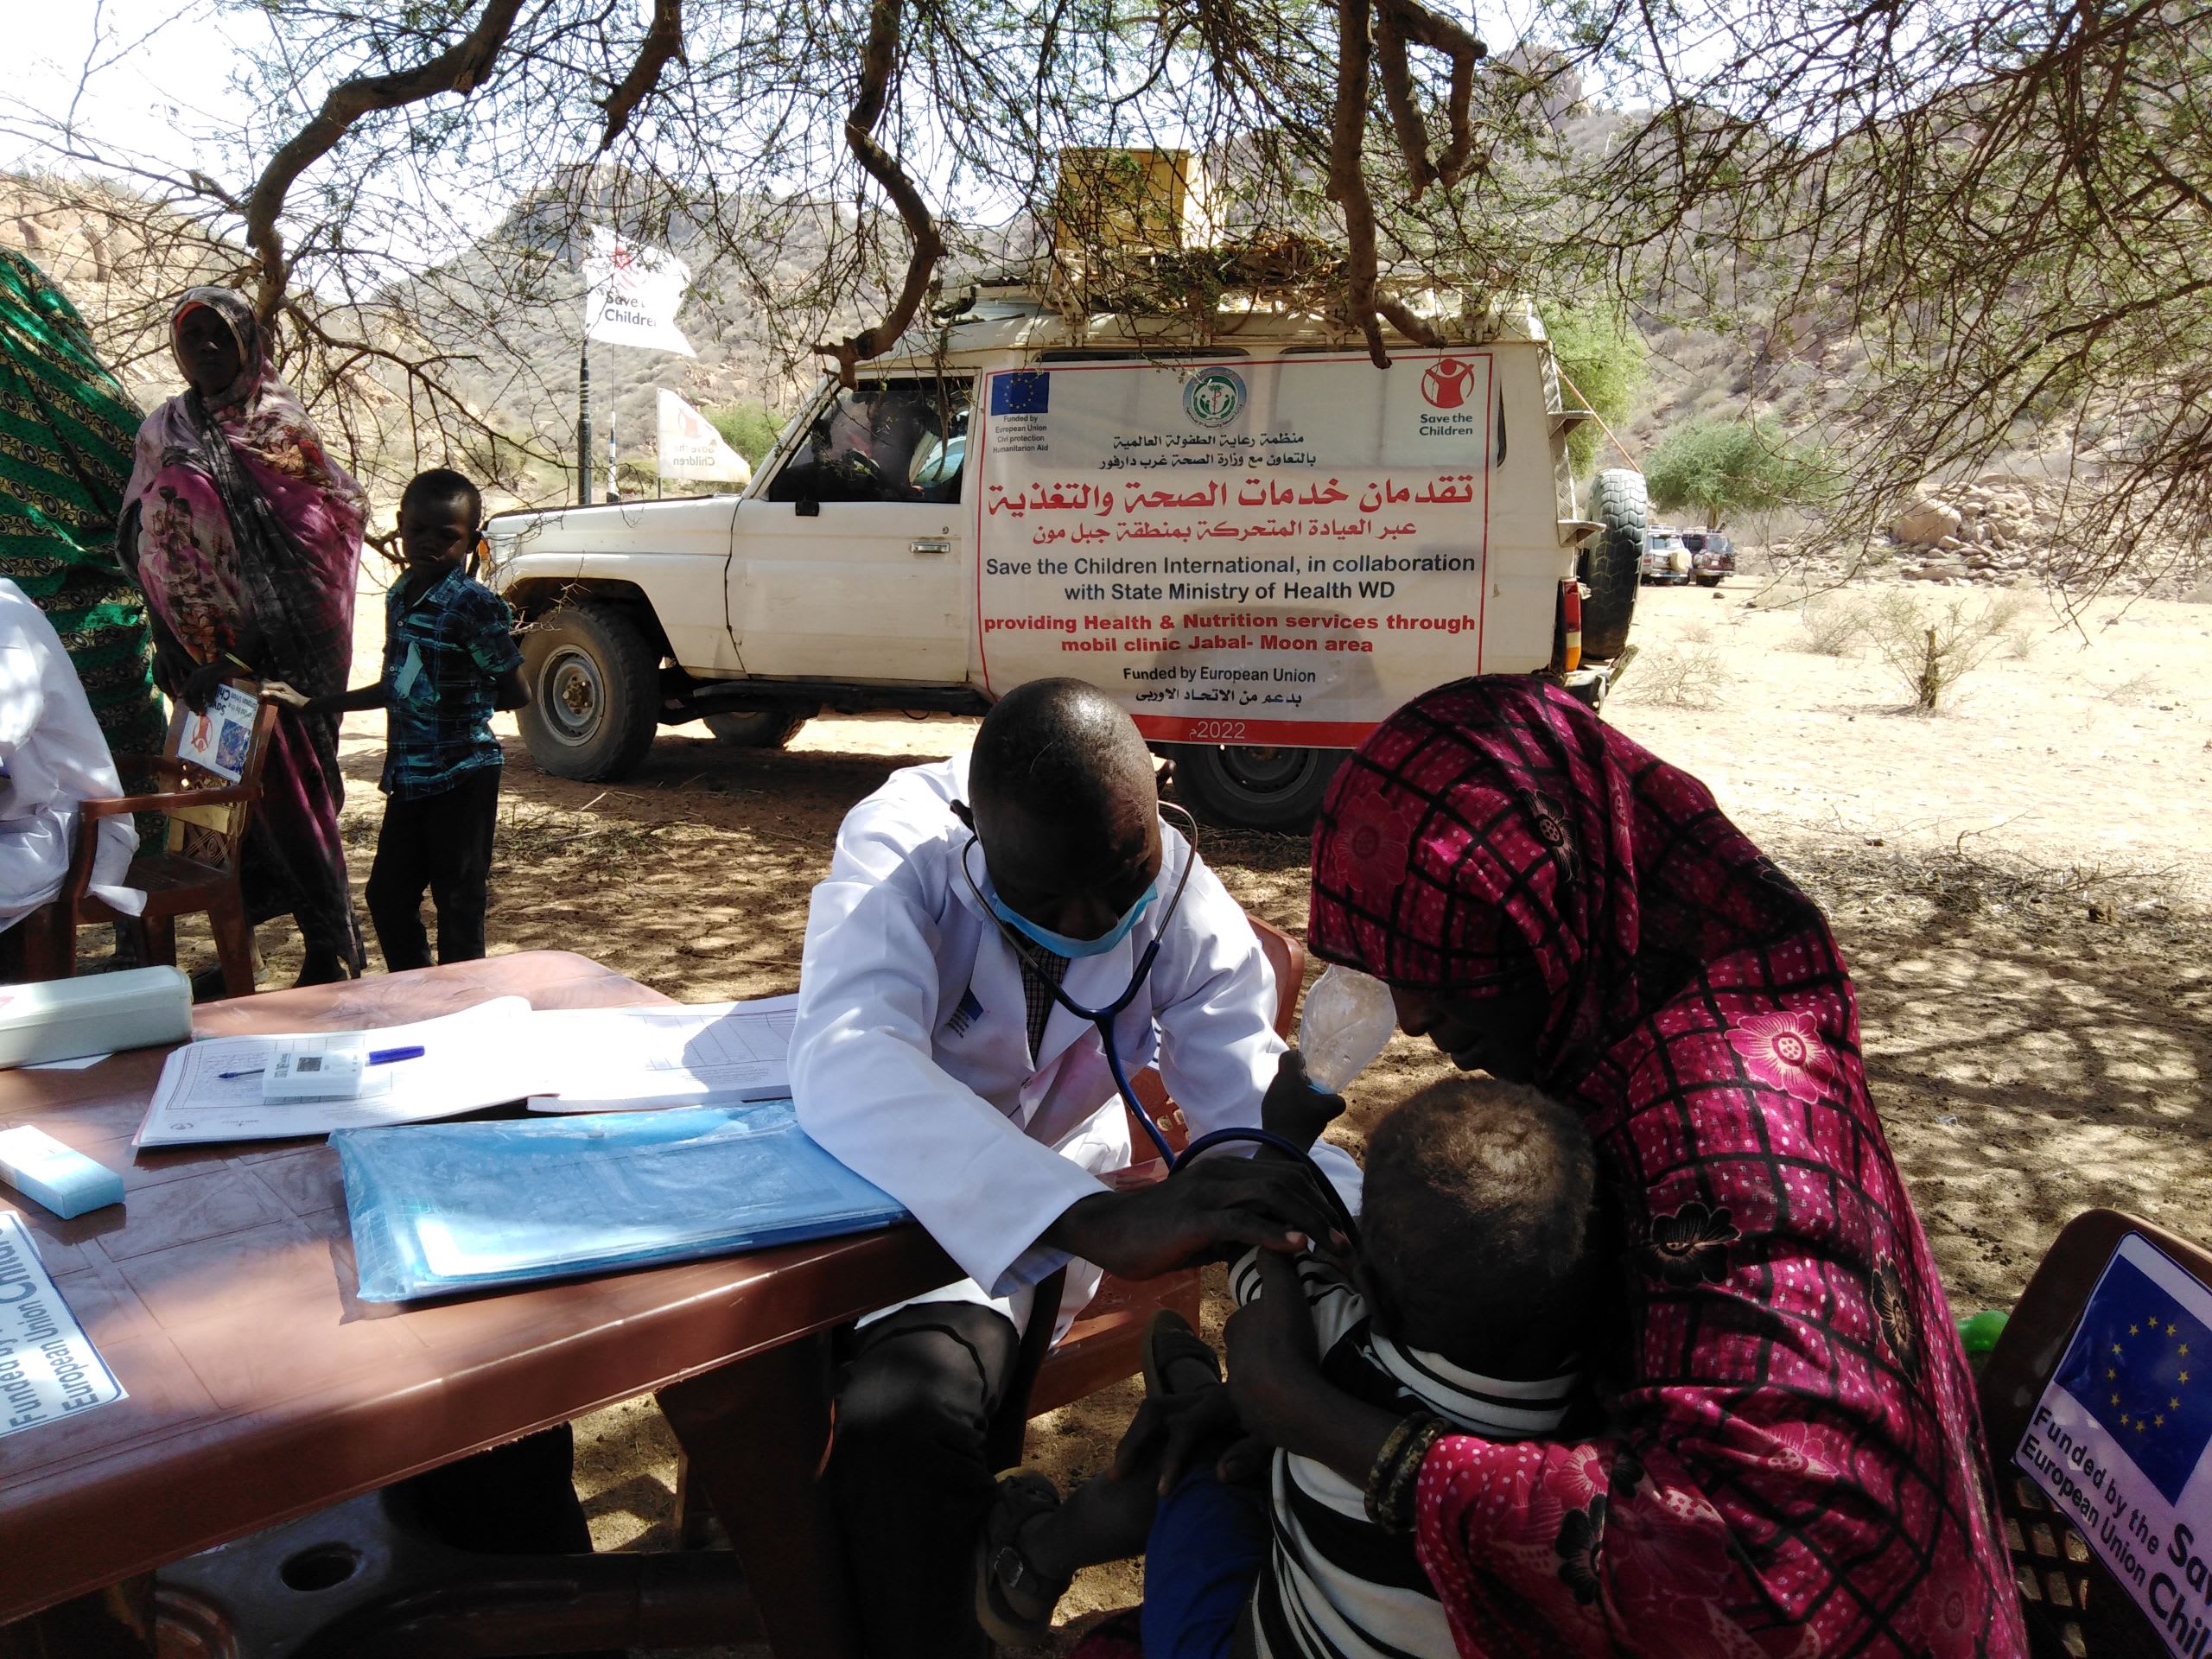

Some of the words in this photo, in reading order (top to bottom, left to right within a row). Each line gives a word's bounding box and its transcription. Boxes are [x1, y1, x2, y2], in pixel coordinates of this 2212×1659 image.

[606, 290, 639, 308] Save
[604, 308, 657, 327] Childre
[1003, 414, 1028, 423] Funded
[1029, 414, 1039, 423] by
[1420, 413, 1450, 424] Save
[1452, 412, 1473, 423] the
[995, 425, 1026, 434] European
[1027, 423, 1047, 432] Union
[1419, 425, 1473, 436] Children
[1009, 434, 1045, 444] protection
[1113, 435, 1162, 450] العالمية
[1165, 434, 1216, 448] الطفولة
[1219, 434, 1255, 448] رعاية
[1259, 432, 1305, 447] منظمة
[1098, 454, 1137, 470] دارفور
[1140, 454, 1168, 469] غرب
[1171, 453, 1214, 467] الصحة
[1217, 452, 1244, 467] وزارة
[1248, 454, 1263, 469] مع
[1266, 451, 1317, 467] بالتعاون
[988, 481, 1115, 518] والتغذية
[1124, 480, 1227, 514] الصحة
[1237, 477, 1350, 506] خدمات
[1358, 474, 1474, 513] تقدمان
[1033, 525, 1066, 545] مون
[1071, 522, 1111, 544] جبل
[1116, 520, 1192, 543] بمنطقة
[1196, 518, 1302, 542] المتحركة
[1307, 518, 1372, 541] العيادة
[1375, 522, 1417, 541] عبر
[986, 558, 1032, 575] Save
[1037, 558, 1068, 575] the
[1074, 557, 1158, 575] Children
[1164, 556, 1301, 575] International,
[1307, 556, 1326, 573] in
[1332, 553, 1476, 573] collaboration
[1065, 582, 1105, 601] with
[1111, 582, 1163, 601] State
[1168, 582, 1249, 603] Ministry
[1255, 582, 1276, 600] of
[1284, 582, 1352, 600] Health
[1357, 581, 1395, 599] WD
[984, 615, 1077, 633] providing
[1084, 615, 1152, 630] Health
[1160, 614, 1175, 630] &
[1183, 613, 1278, 629] Nutrition
[1285, 614, 1379, 629] services
[1386, 613, 1475, 634] through
[1061, 638, 1117, 652] mobil
[1123, 638, 1180, 652] clinic
[1187, 635, 1254, 650] Jabal-
[1260, 635, 1318, 651] Moon
[1325, 639, 1374, 652] area
[1122, 665, 1177, 681] Funded
[1180, 665, 1196, 683] by
[1199, 665, 1269, 683] European
[1273, 667, 1316, 683] Union
[1238, 689, 1258, 706] من
[1261, 693, 1303, 708] بدعم
[16, 1300, 60, 1344] Union
[40, 1339, 99, 1413] European
[2033, 1406, 2107, 1490] Funded
[2104, 1478, 2128, 1520] by
[2127, 1508, 2160, 1555] the
[2020, 1434, 2100, 1529] European
[2100, 1516, 2146, 1588] Union
